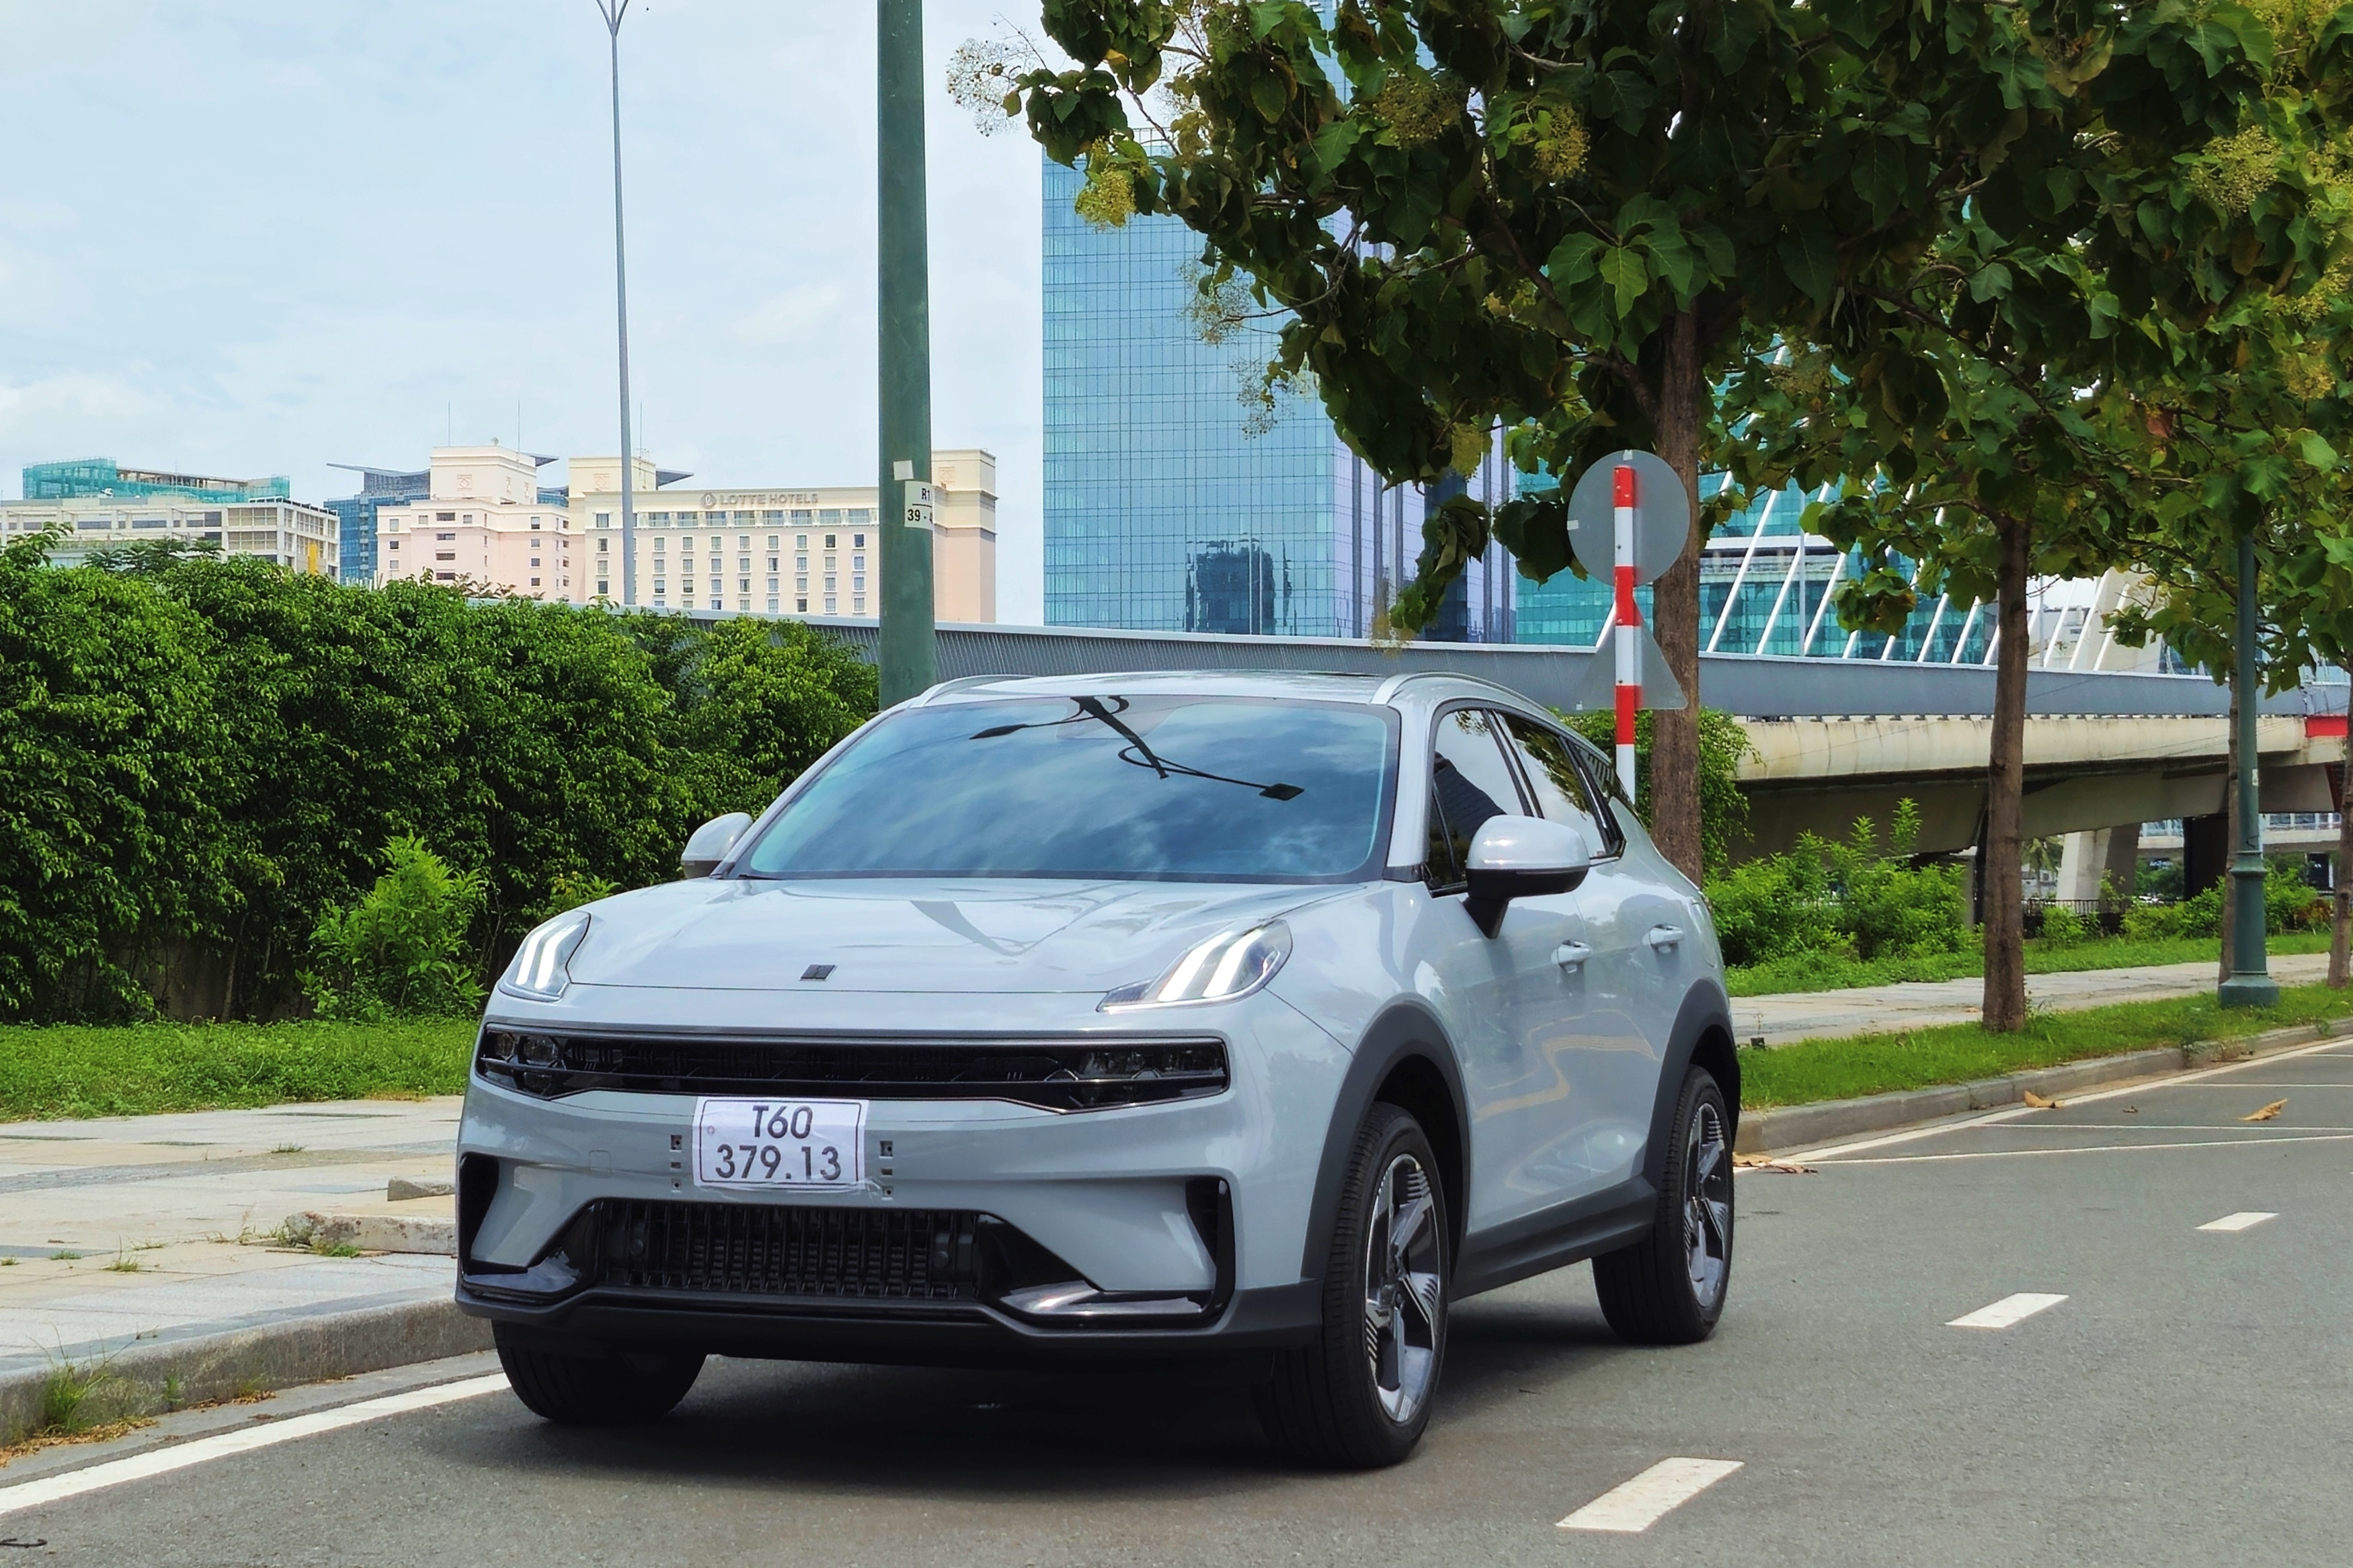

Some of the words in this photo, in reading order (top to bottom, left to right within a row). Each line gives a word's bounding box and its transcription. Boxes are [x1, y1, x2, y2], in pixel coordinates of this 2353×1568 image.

[719, 493, 766, 505] LOTTE
[769, 493, 818, 504] HOTELS
[752, 1104, 813, 1139] T60
[715, 1143, 842, 1181] 379.13
